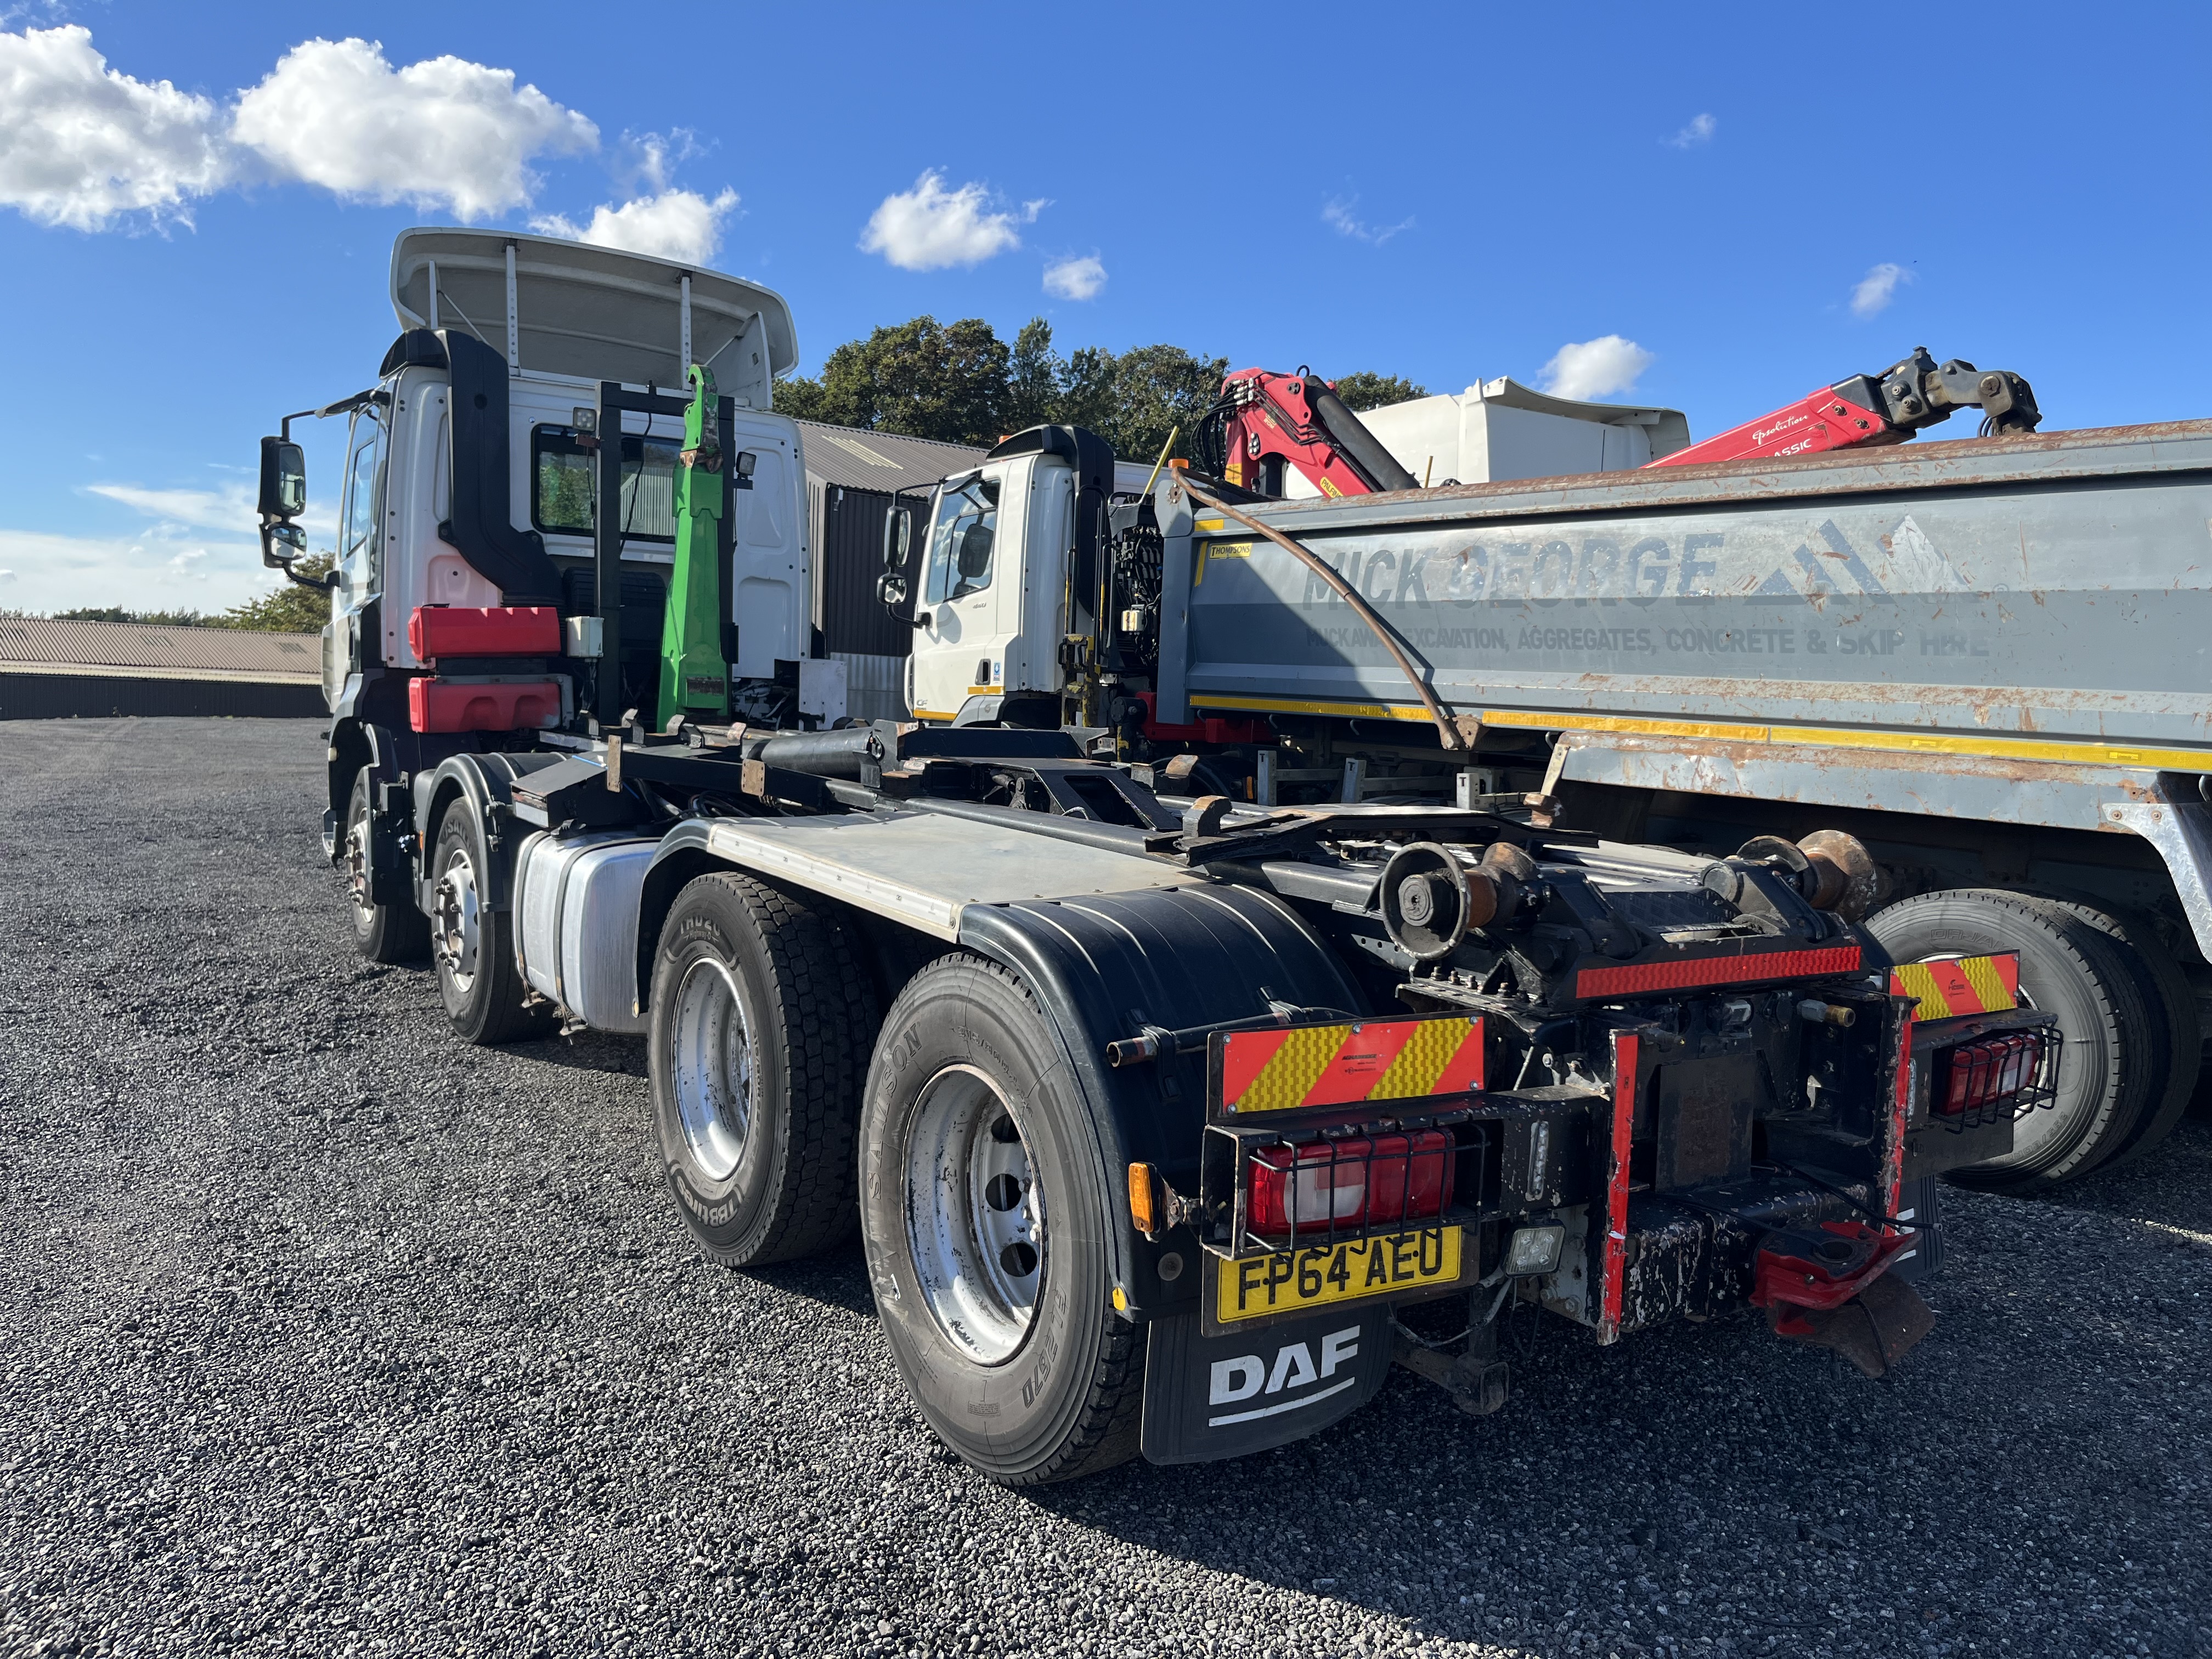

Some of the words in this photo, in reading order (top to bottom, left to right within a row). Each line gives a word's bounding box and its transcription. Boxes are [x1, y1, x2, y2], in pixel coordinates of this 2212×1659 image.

[1752, 415, 1809, 445] Epsolution
[1767, 438, 1813, 458] ASSIC
[1211, 545, 1250, 557] THOMPSONS
[1302, 548, 1440, 611] MICK
[1449, 532, 1725, 609] GEORGE
[1306, 628, 1386, 649] MUCKAWA
[1402, 627, 1510, 653] EXCAVATION,
[1517, 627, 1658, 656] AGGREGATES,
[1666, 628, 1796, 654] CONCRETE
[1806, 629, 1828, 654] &
[1838, 629, 1906, 656] SKIP
[1921, 630, 1990, 657] HIRE
[1459, 777, 1467, 787] T
[867, 1022, 923, 1200] SAMSON
[1238, 1245, 1350, 1311] FP64
[1364, 1227, 1443, 1288] AEU
[1209, 1325, 1361, 1406] DAF
